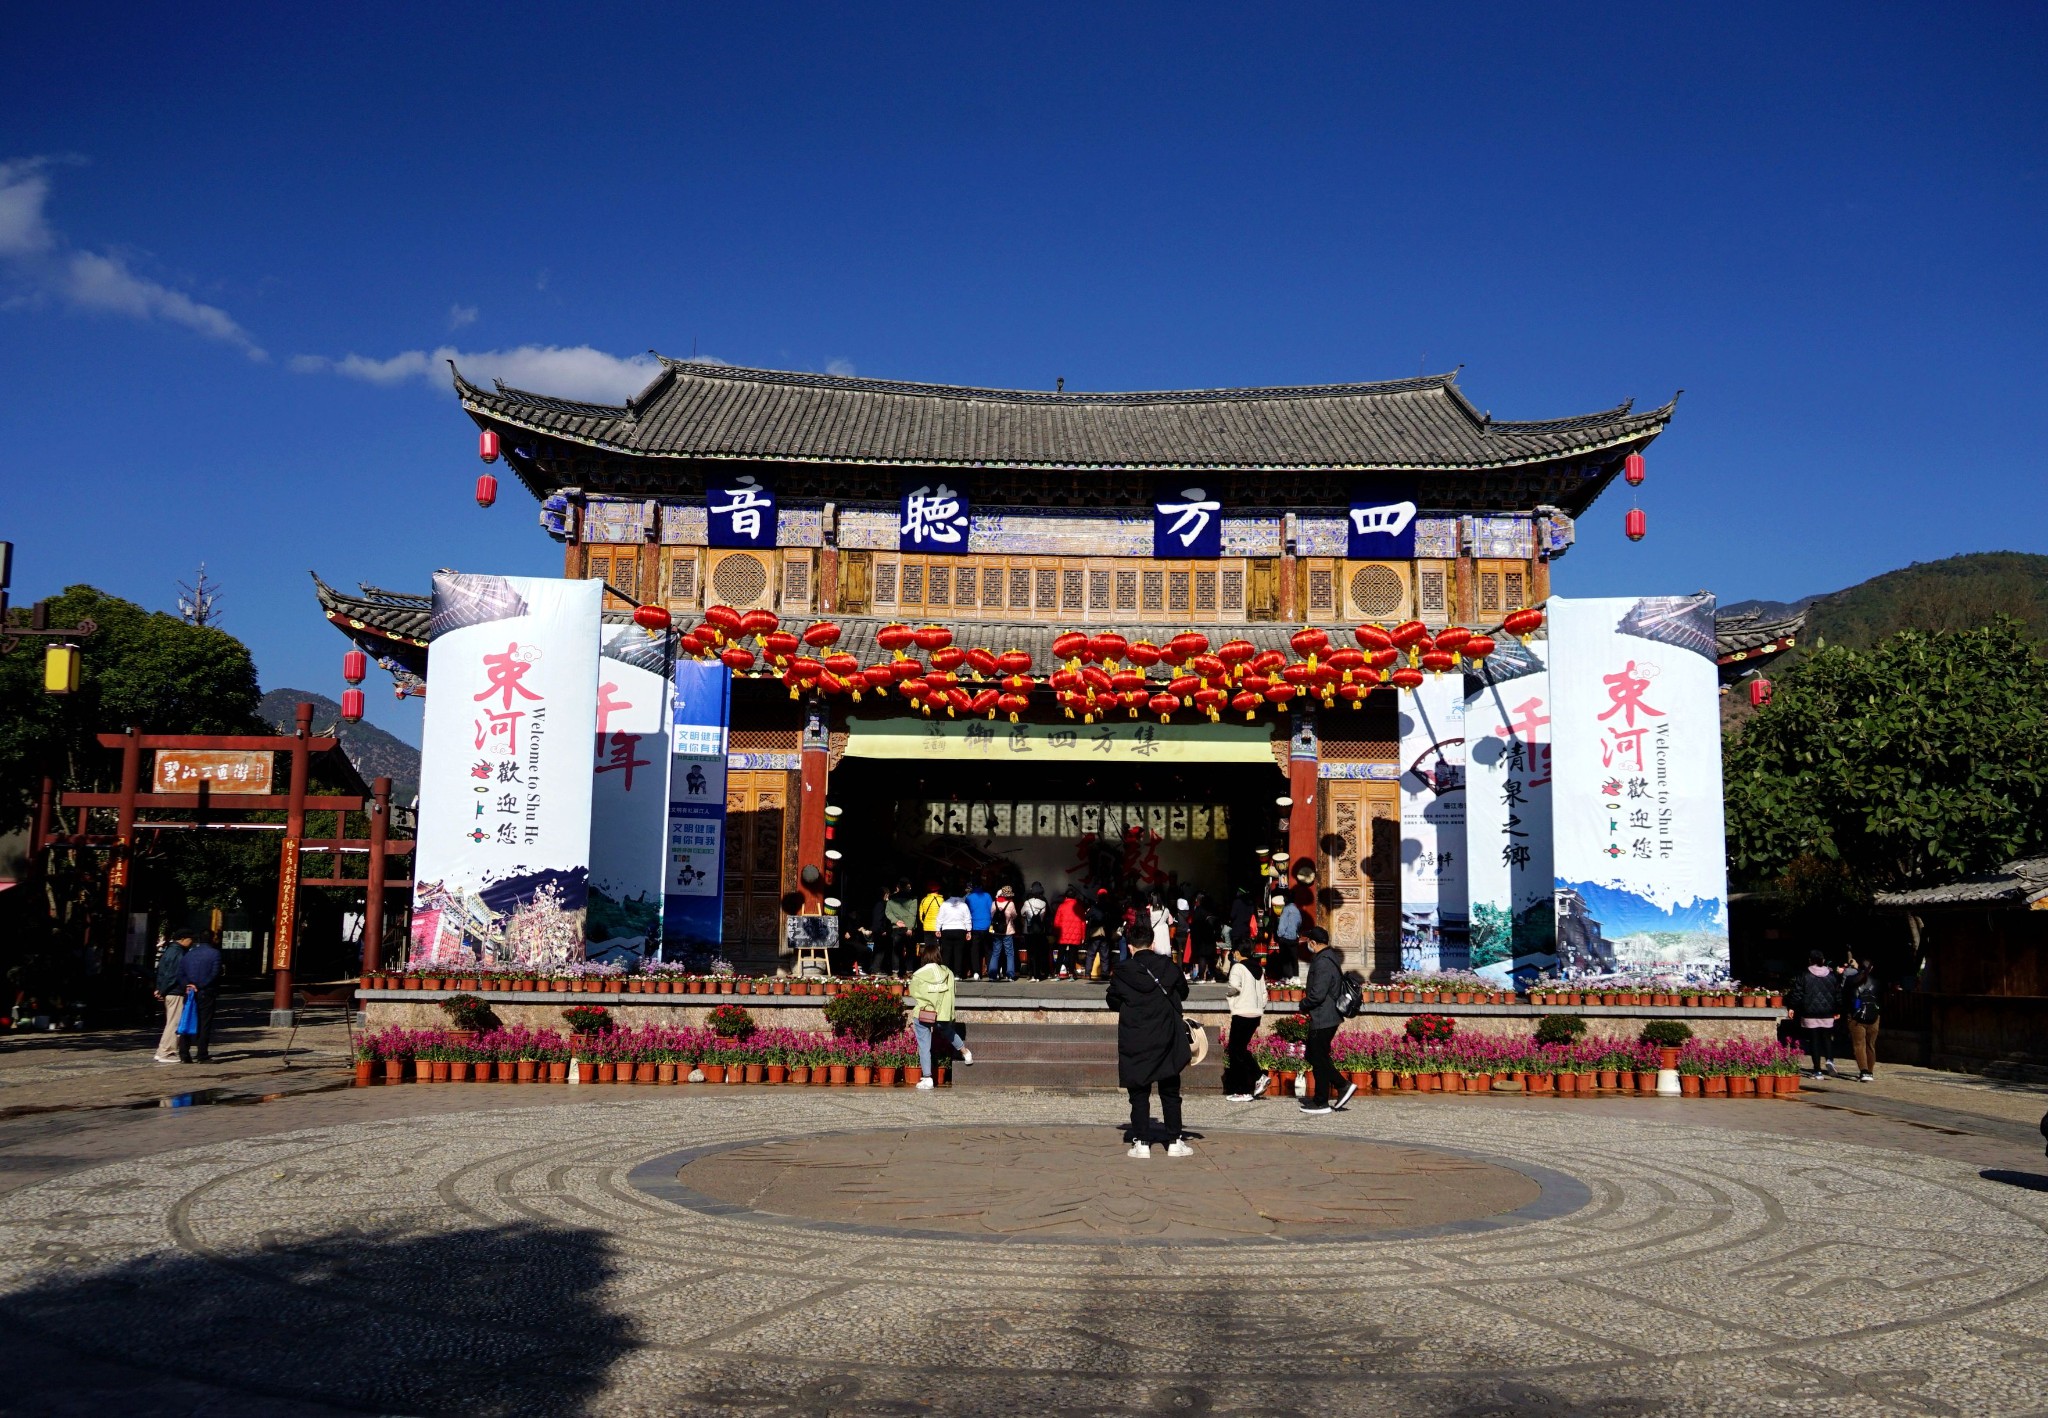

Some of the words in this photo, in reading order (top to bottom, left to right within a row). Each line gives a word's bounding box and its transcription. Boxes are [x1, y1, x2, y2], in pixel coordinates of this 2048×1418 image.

[710, 476, 771, 539] 音
[901, 483, 968, 543] 聽
[1156, 487, 1221, 548] 方
[1349, 500, 1417, 537] 四
[473, 642, 545, 757] 束河
[1597, 660, 1667, 773] 束河
[529, 707, 546, 773] Welcome
[677, 742, 721, 754] 有你有我
[678, 731, 722, 742] 文明健康
[1655, 722, 1669, 787] Welcome
[527, 776, 540, 790] to
[1658, 790, 1668, 805] to
[496, 760, 525, 846] 歡迎您
[526, 793, 541, 822] Shu
[1626, 775, 1655, 861] 歡迎您
[524, 825, 539, 846] He
[672, 823, 716, 834] 文明健康
[1658, 808, 1672, 835] Shu
[672, 835, 715, 847] 有你有我
[1660, 839, 1673, 860] He
